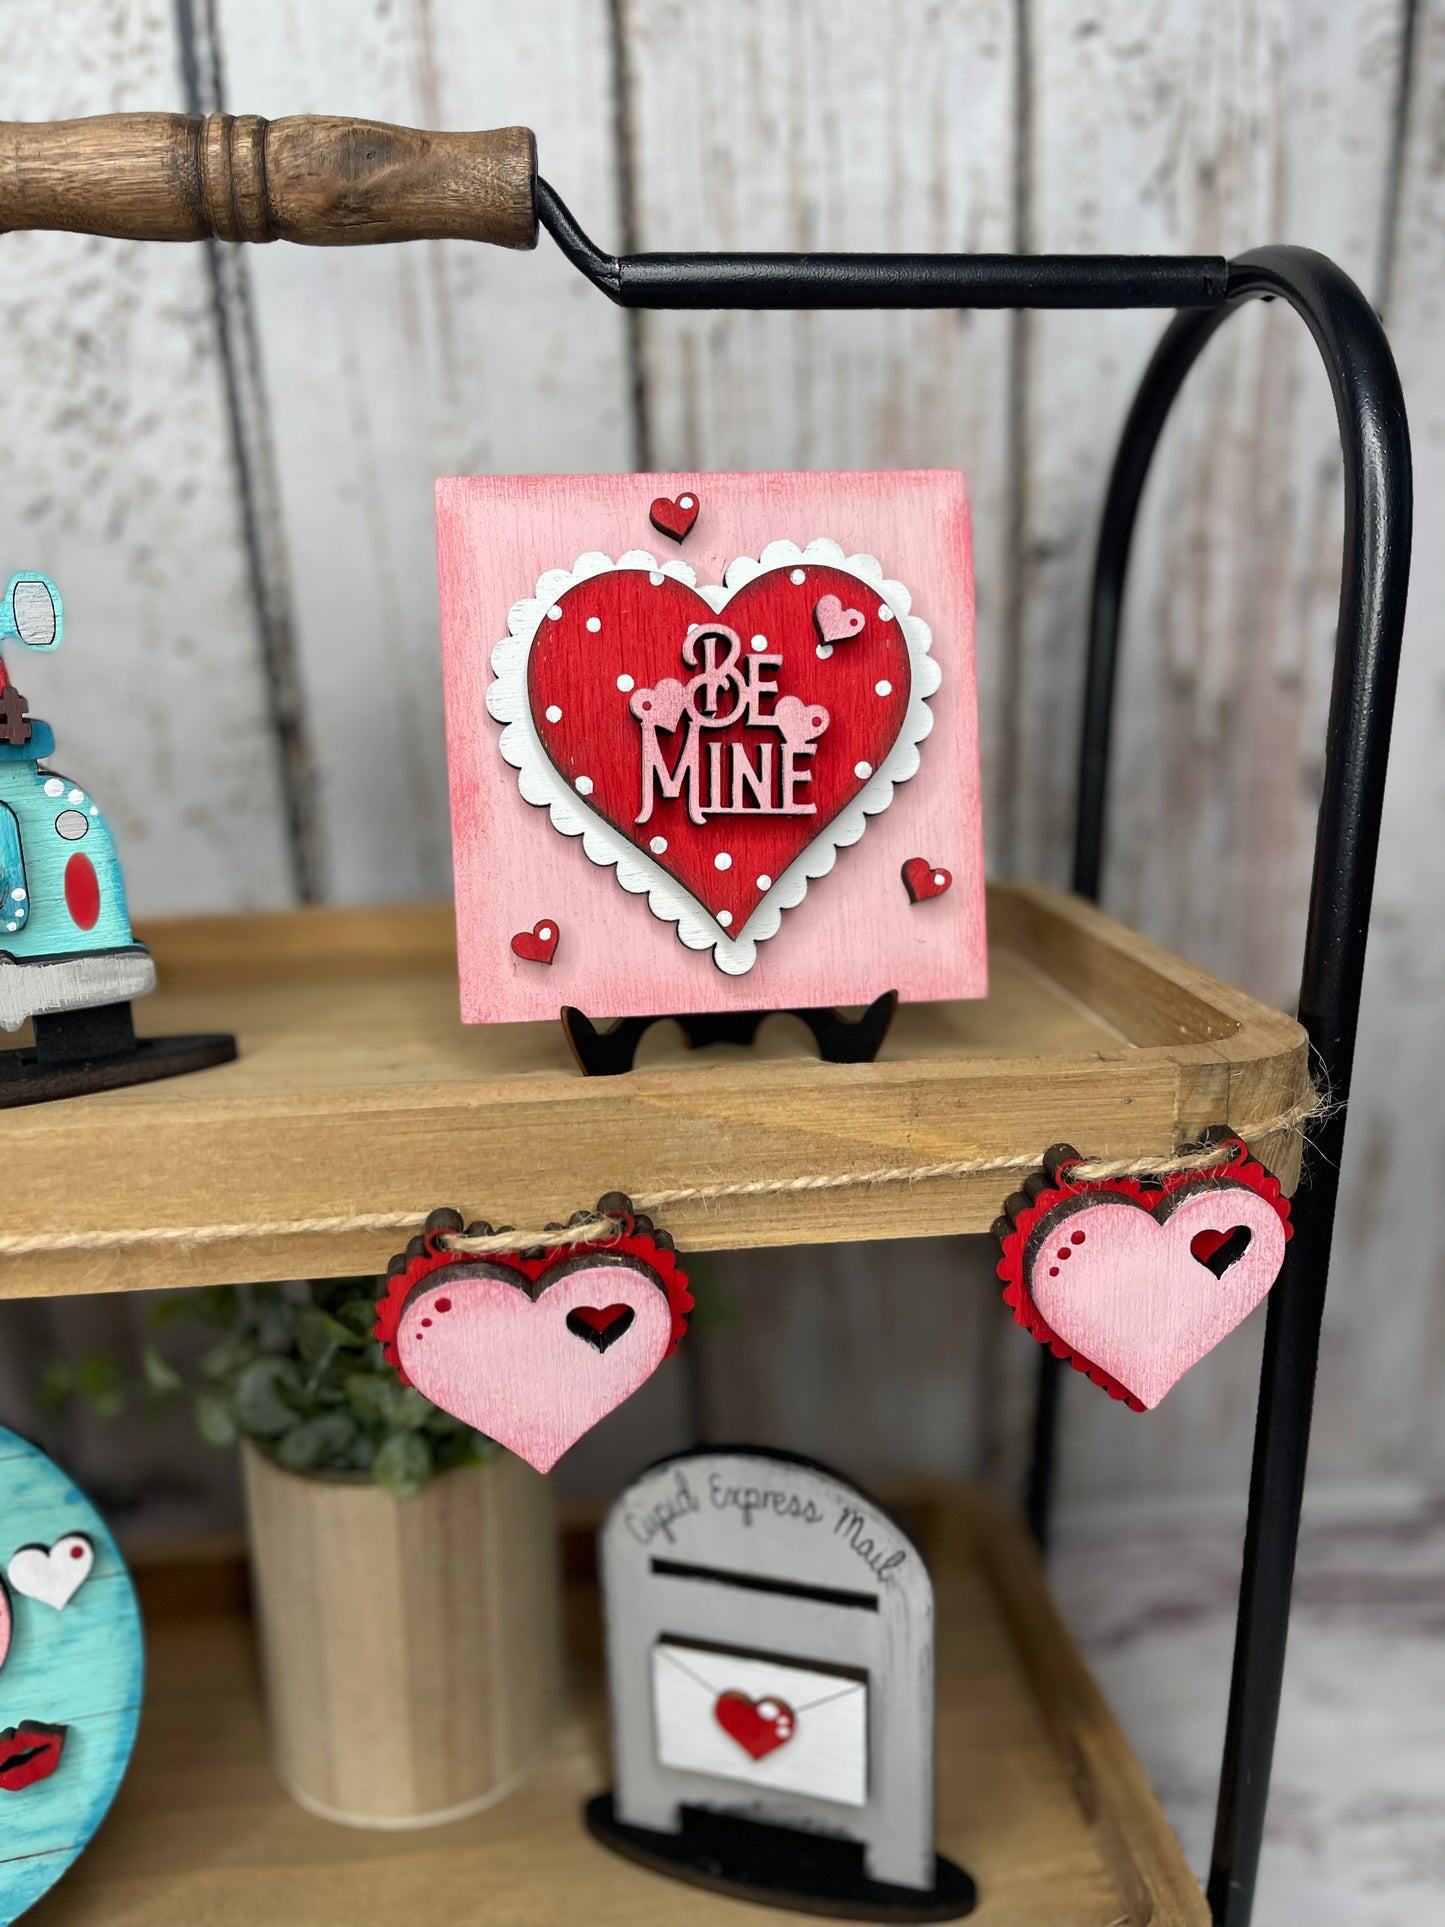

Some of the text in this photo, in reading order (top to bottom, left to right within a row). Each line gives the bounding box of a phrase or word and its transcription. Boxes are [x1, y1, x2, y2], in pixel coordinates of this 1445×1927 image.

[634, 719, 818, 825] MINE
[624, 1469, 907, 1584] Cupid Express Mail
